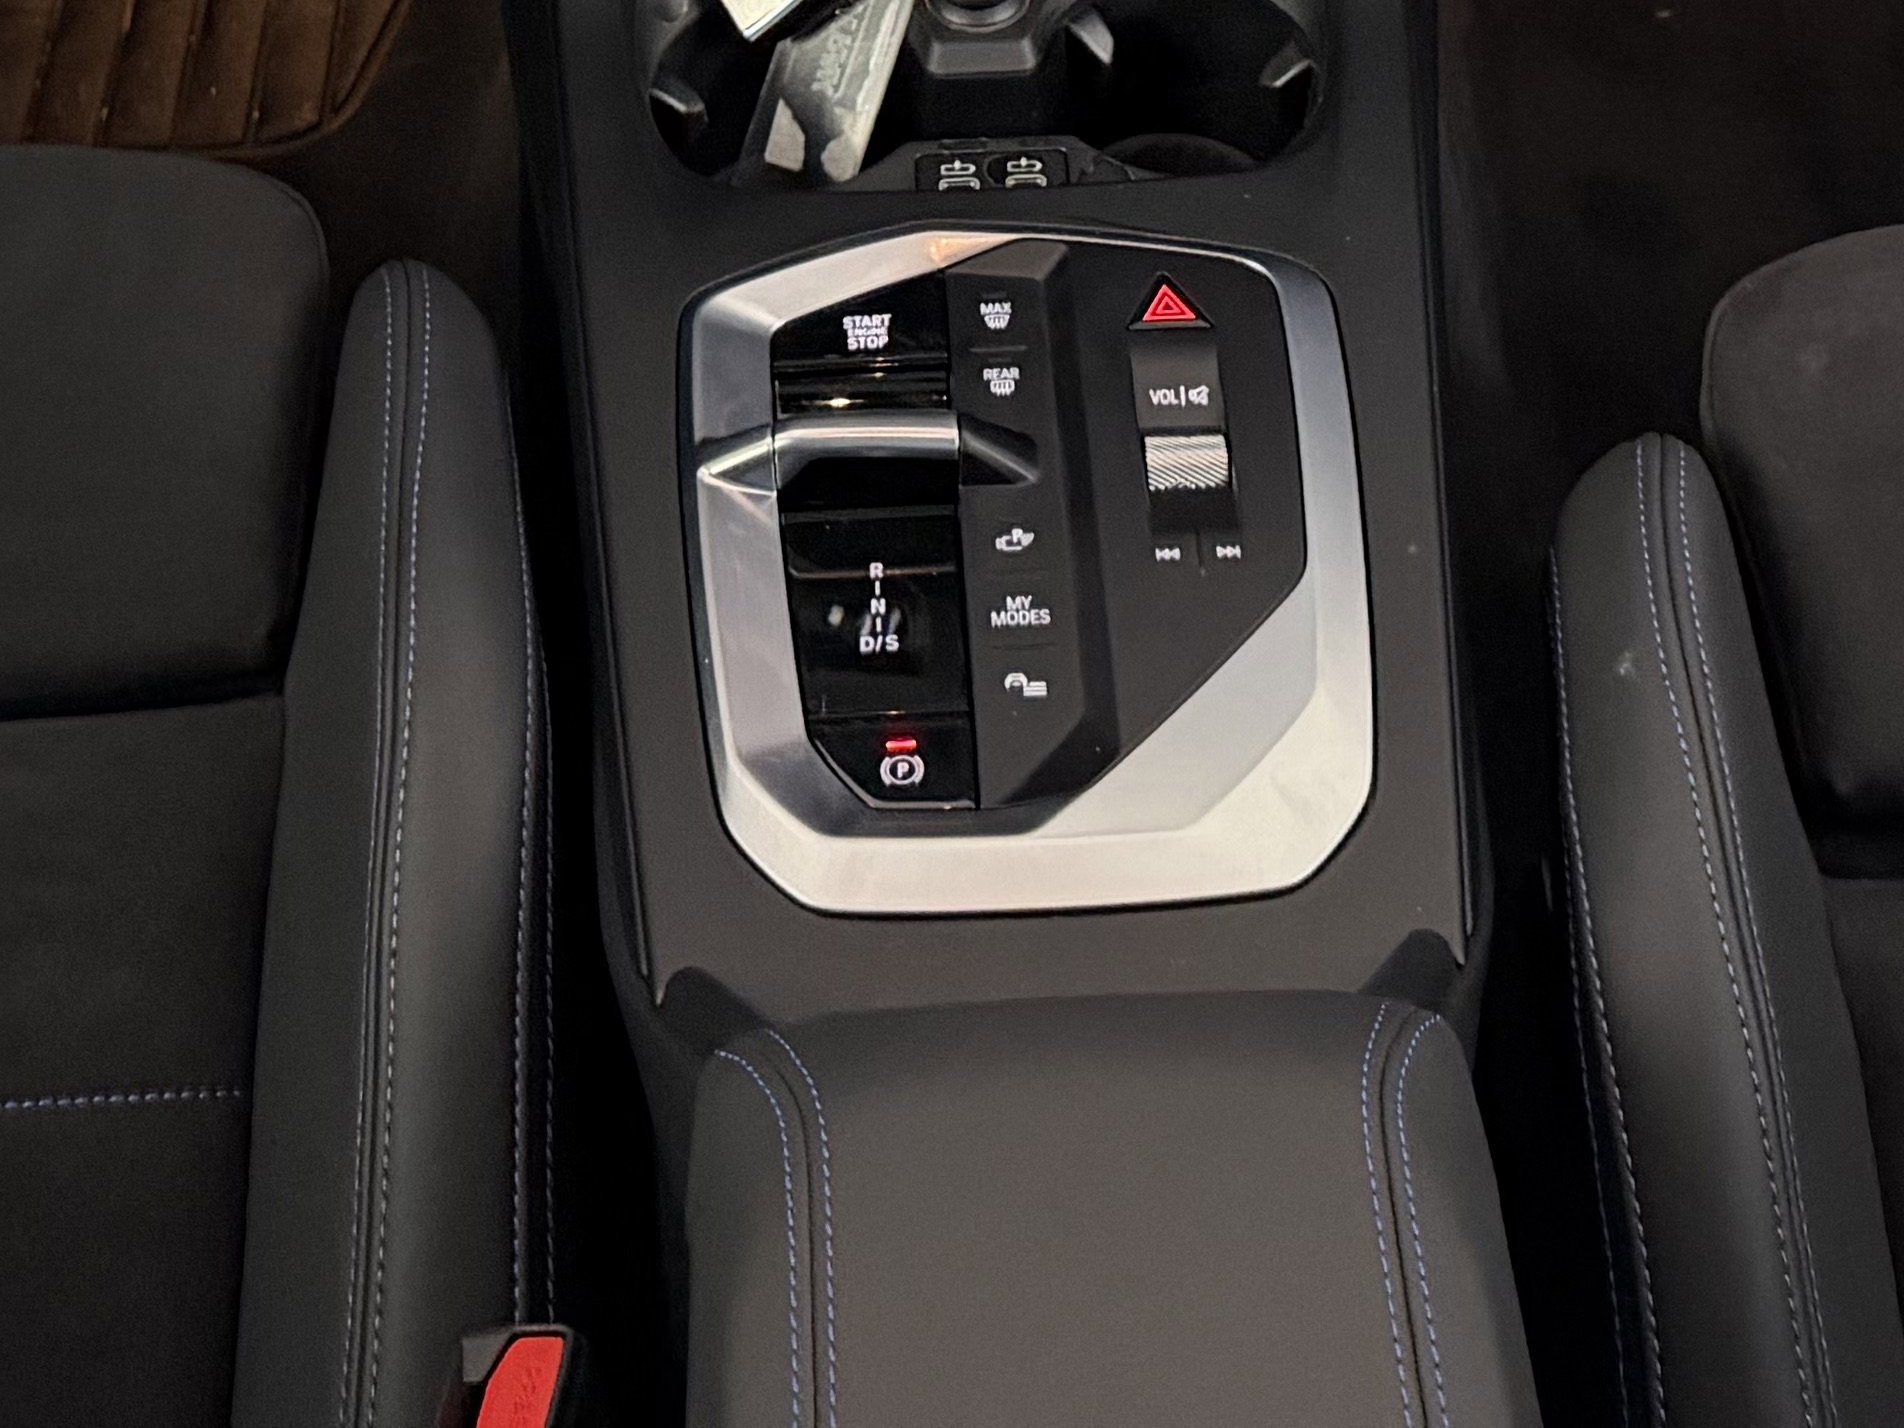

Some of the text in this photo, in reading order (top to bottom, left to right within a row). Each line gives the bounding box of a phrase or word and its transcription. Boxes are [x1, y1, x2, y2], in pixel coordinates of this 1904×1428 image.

[979, 301, 1012, 316] MAX
[842, 312, 893, 331] START
[847, 335, 889, 351] STOP
[982, 366, 1021, 382] REAR
[1149, 387, 1180, 407] VOL
[869, 561, 884, 579] R
[870, 597, 886, 615] N
[1006, 595, 1033, 611] MY
[990, 608, 1052, 629] MODES
[859, 633, 900, 656] D/S
